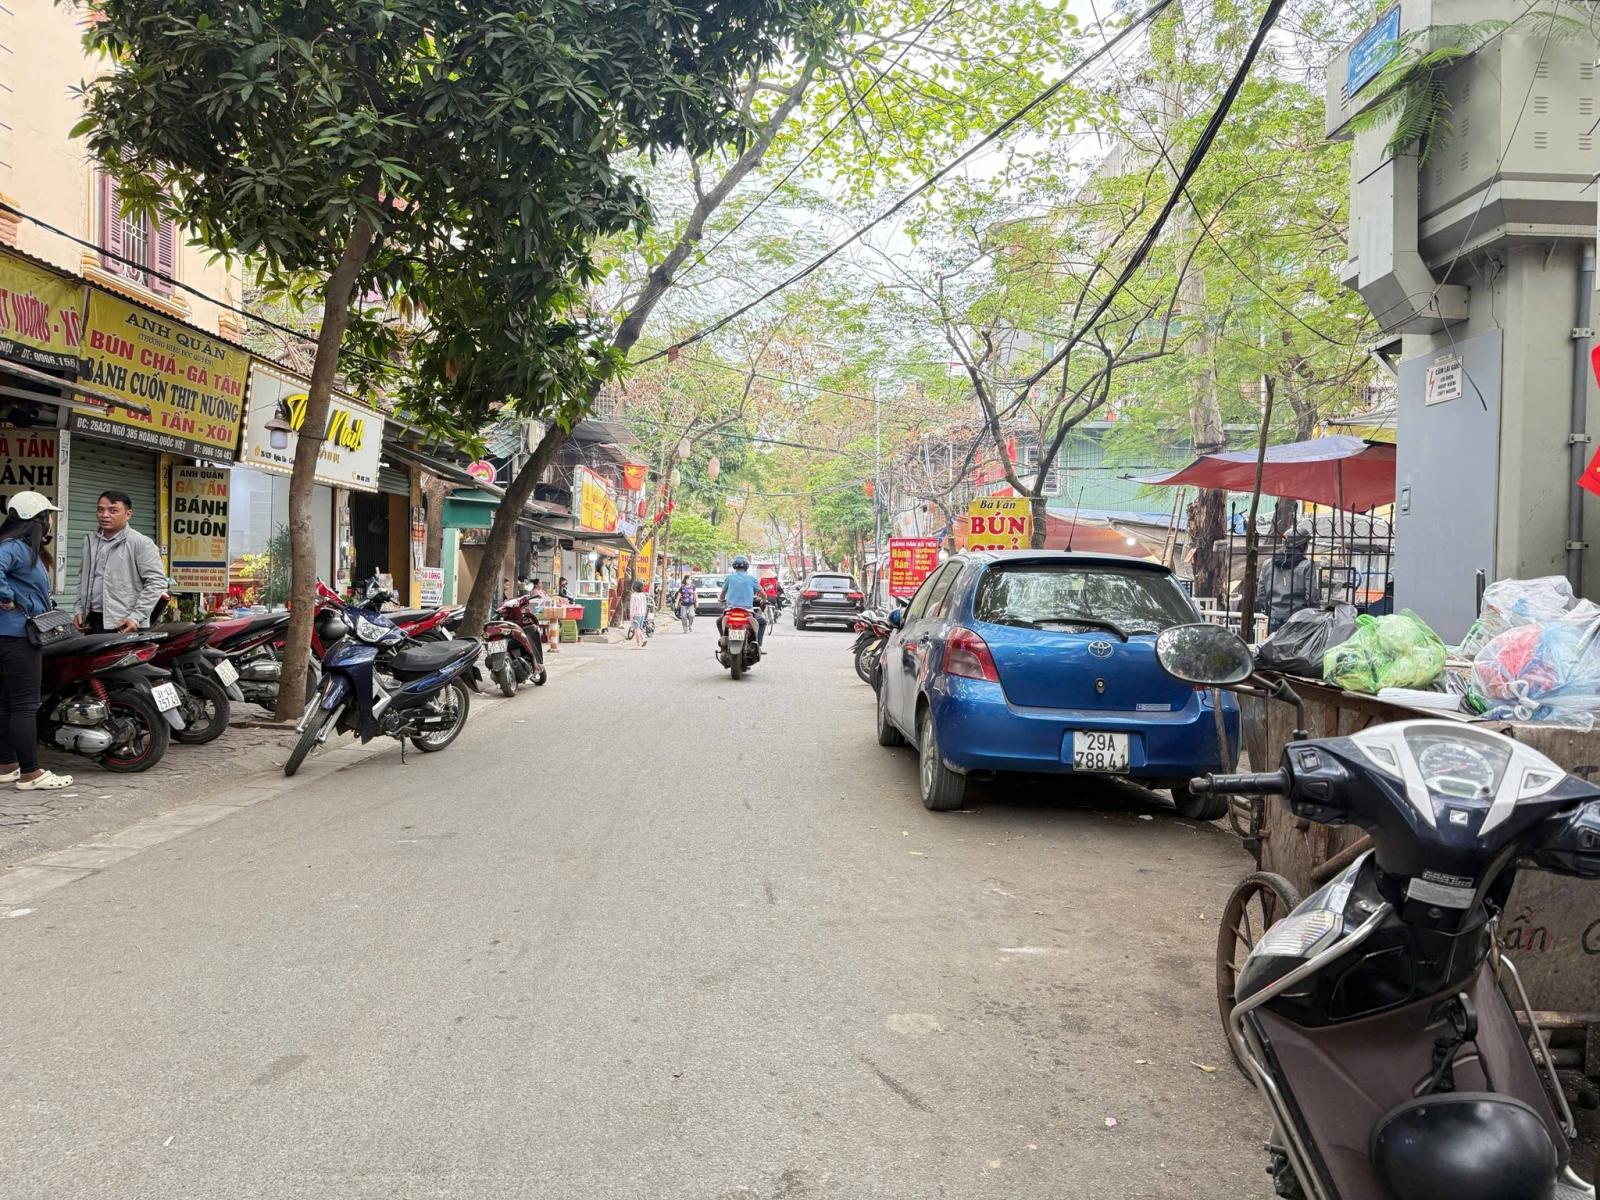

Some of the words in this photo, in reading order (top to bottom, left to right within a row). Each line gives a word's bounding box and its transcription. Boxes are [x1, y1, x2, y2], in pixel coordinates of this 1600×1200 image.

[12, 290, 50, 343] NƯỚNG
[126, 312, 171, 340] ANH
[176, 333, 226, 361] QUÂN
[89, 329, 135, 361] BÚN
[140, 348, 177, 376] CHẢ
[186, 364, 208, 386] GÀ
[86, 356, 128, 391] BÁNH
[130, 371, 168, 403] CUỐN
[170, 383, 199, 414] THỊT
[199, 392, 239, 423] NƯỚNG
[126, 427, 138, 439] 385
[138, 429, 159, 444] HOÀNG
[205, 424, 233, 443] XÔI
[180, 469, 198, 478] ANH
[200, 469, 224, 480] QUÂN
[174, 494, 227, 516] BÁNH
[173, 515, 227, 538] CUỐN
[970, 511, 1026, 535] BÚN
[173, 536, 198, 557] XÔI
[1087, 733, 1116, 751] 29A
